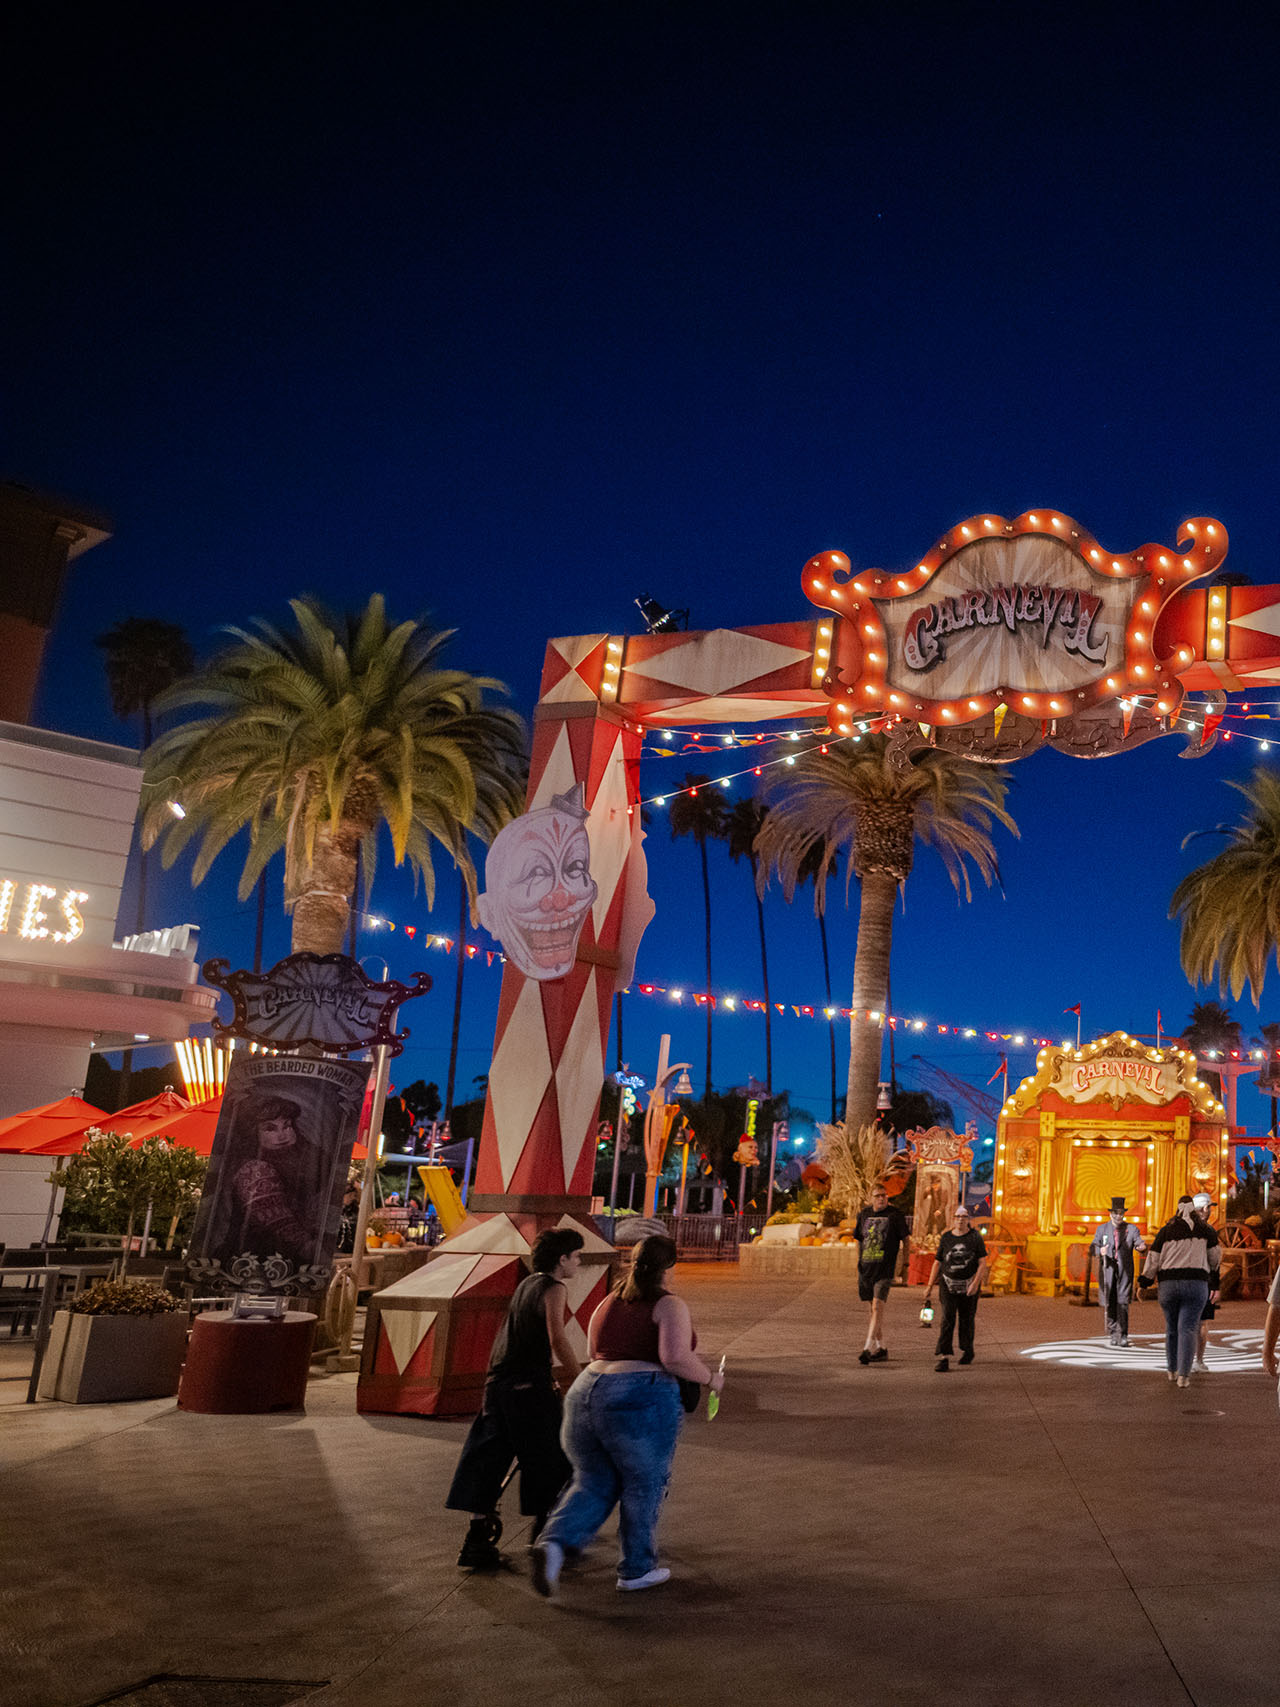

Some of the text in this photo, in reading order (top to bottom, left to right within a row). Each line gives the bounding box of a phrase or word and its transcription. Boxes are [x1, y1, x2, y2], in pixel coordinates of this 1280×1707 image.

[905, 582, 1109, 673] CARNEVIL
[258, 984, 370, 1026] CARNEVIL
[266, 1060, 315, 1074] BEARDED
[317, 1064, 355, 1087] WOMAN
[1071, 1061, 1166, 1095] CARNEVIL
